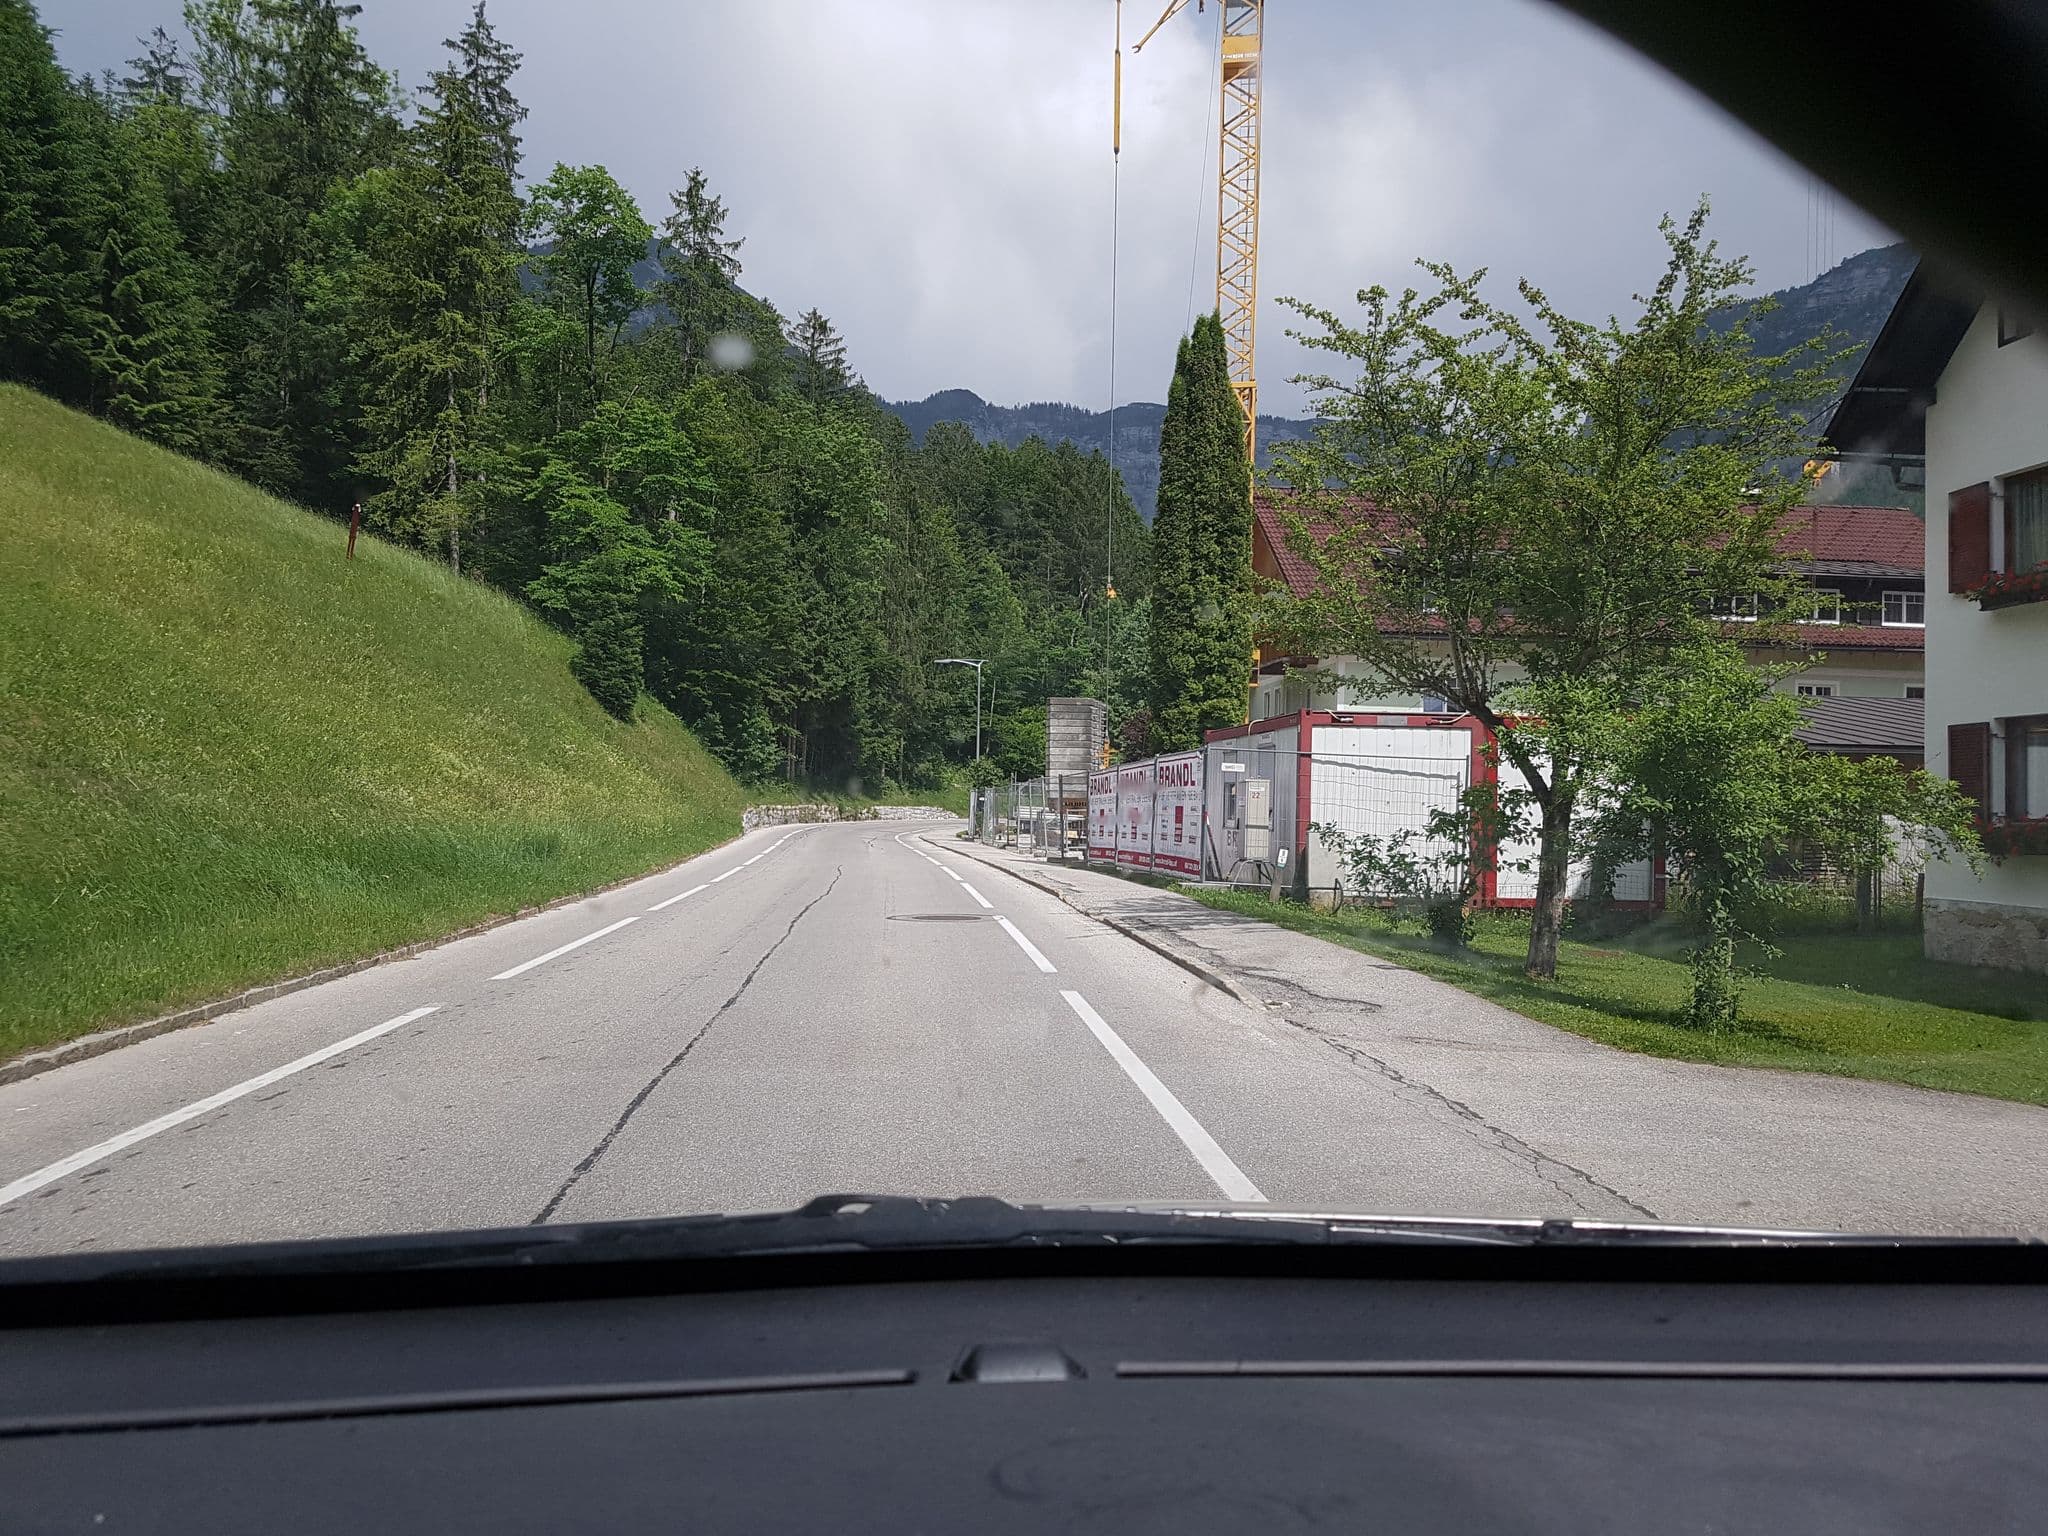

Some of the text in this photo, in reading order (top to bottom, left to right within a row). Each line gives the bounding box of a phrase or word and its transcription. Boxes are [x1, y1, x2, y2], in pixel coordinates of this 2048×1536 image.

[1159, 762, 1196, 787] BRANDL
[1090, 775, 1112, 796] BRANDL
[1251, 791, 1261, 799] 22
